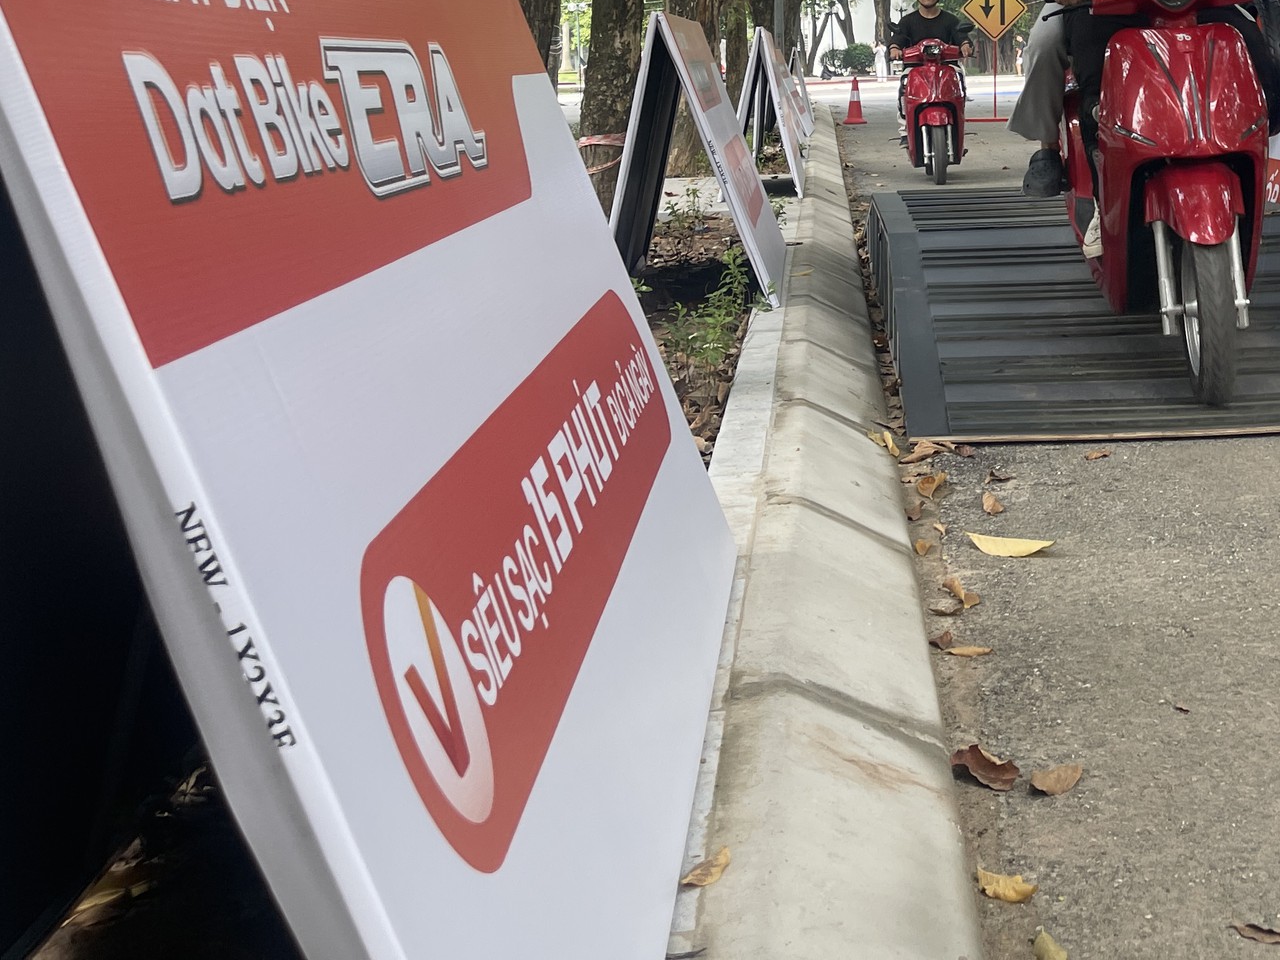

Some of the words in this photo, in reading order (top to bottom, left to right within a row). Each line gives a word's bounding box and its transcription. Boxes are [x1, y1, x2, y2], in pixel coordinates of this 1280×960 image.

[122, 50, 266, 201] Dat
[233, 52, 349, 180] Bike
[319, 35, 489, 200] ERA
[615, 360, 640, 429] CẢ
[625, 343, 655, 415] NGÀY
[521, 455, 573, 574] 15
[547, 379, 620, 535] PHÚT
[502, 524, 553, 629] SẠC
[461, 572, 522, 706] SIÊU
